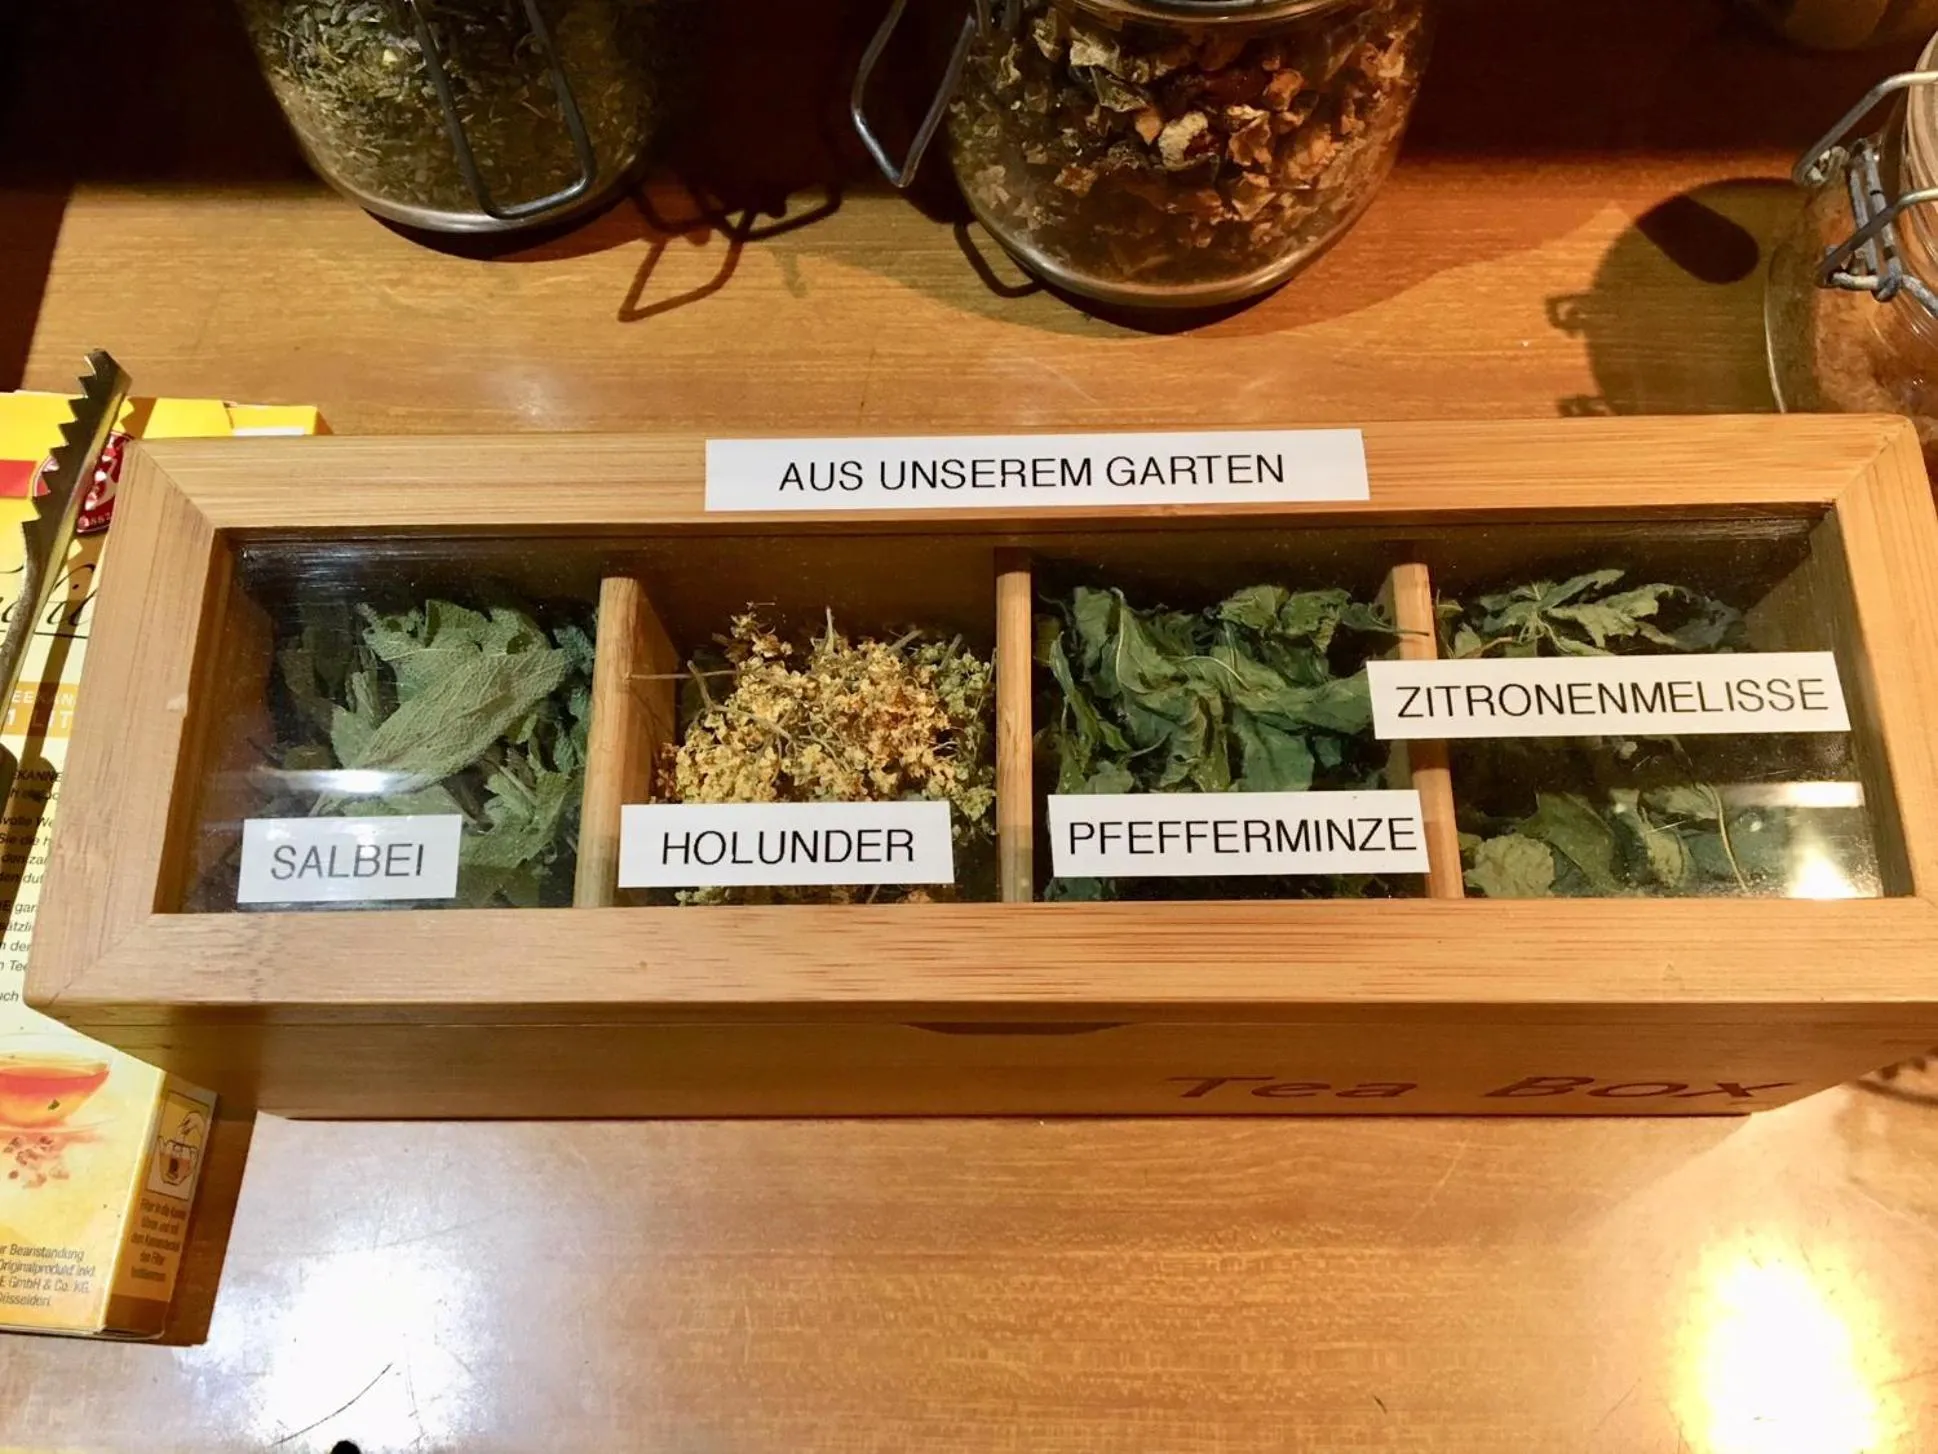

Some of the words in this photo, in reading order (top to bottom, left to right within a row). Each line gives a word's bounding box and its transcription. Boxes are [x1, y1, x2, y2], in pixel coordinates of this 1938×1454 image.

[779, 461, 864, 492] AUS
[880, 457, 1092, 490] UNSEREM
[1106, 453, 1284, 486] GARTEN
[1396, 679, 1828, 718] ZITRONENMELISSE
[662, 829, 915, 866] HOLUNDER
[1069, 817, 1418, 855] PFEFFERMINZE
[271, 844, 425, 880] SALBEI
[1166, 1076, 1417, 1099] Tea
